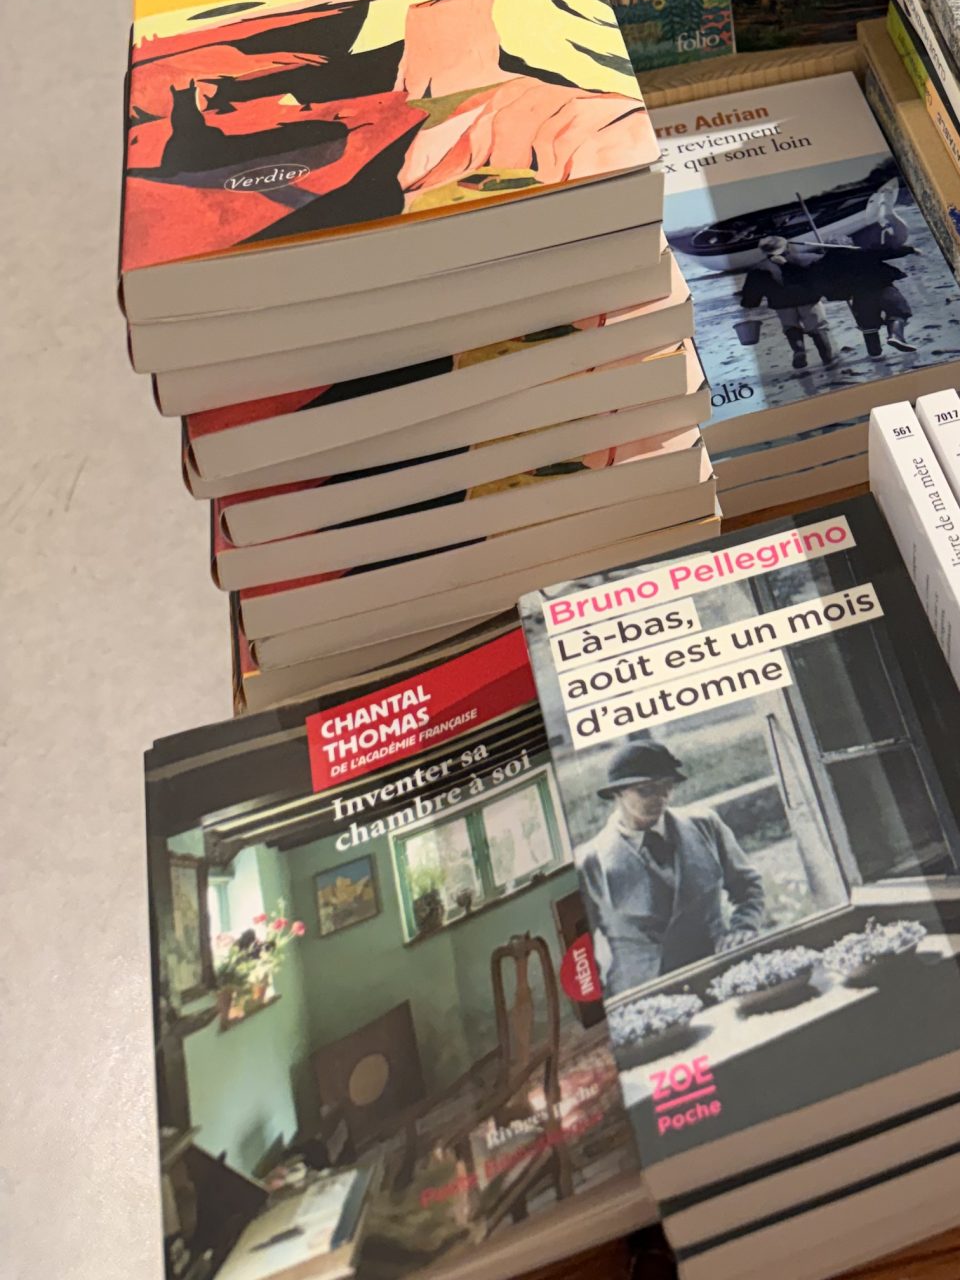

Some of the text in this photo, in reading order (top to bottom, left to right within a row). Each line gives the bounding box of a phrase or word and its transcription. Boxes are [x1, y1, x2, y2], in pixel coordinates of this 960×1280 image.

[675, 30, 721, 53] folio
[676, 124, 783, 155] reviennent
[695, 103, 770, 131] Adrian
[684, 134, 813, 177] qui sont loin
[892, 425, 912, 438] 561
[934, 409, 959, 423] 7017
[549, 526, 848, 625] Bruno Pellegrino
[557, 609, 694, 662] Là-bas,
[567, 592, 875, 699] août est un mois
[320, 685, 432, 739] CHANTAL
[575, 661, 783, 737] d'automne
[322, 706, 430, 763] THOMAS
[330, 708, 479, 778] DE L'ACADÉMIE FRANÇAISE
[332, 744, 490, 822] Inventer sa
[335, 748, 533, 853] chambre à soi
[572, 946, 595, 996] INÉDIT
[649, 1055, 715, 1101] ZOE
[657, 1099, 723, 1137] Poche
